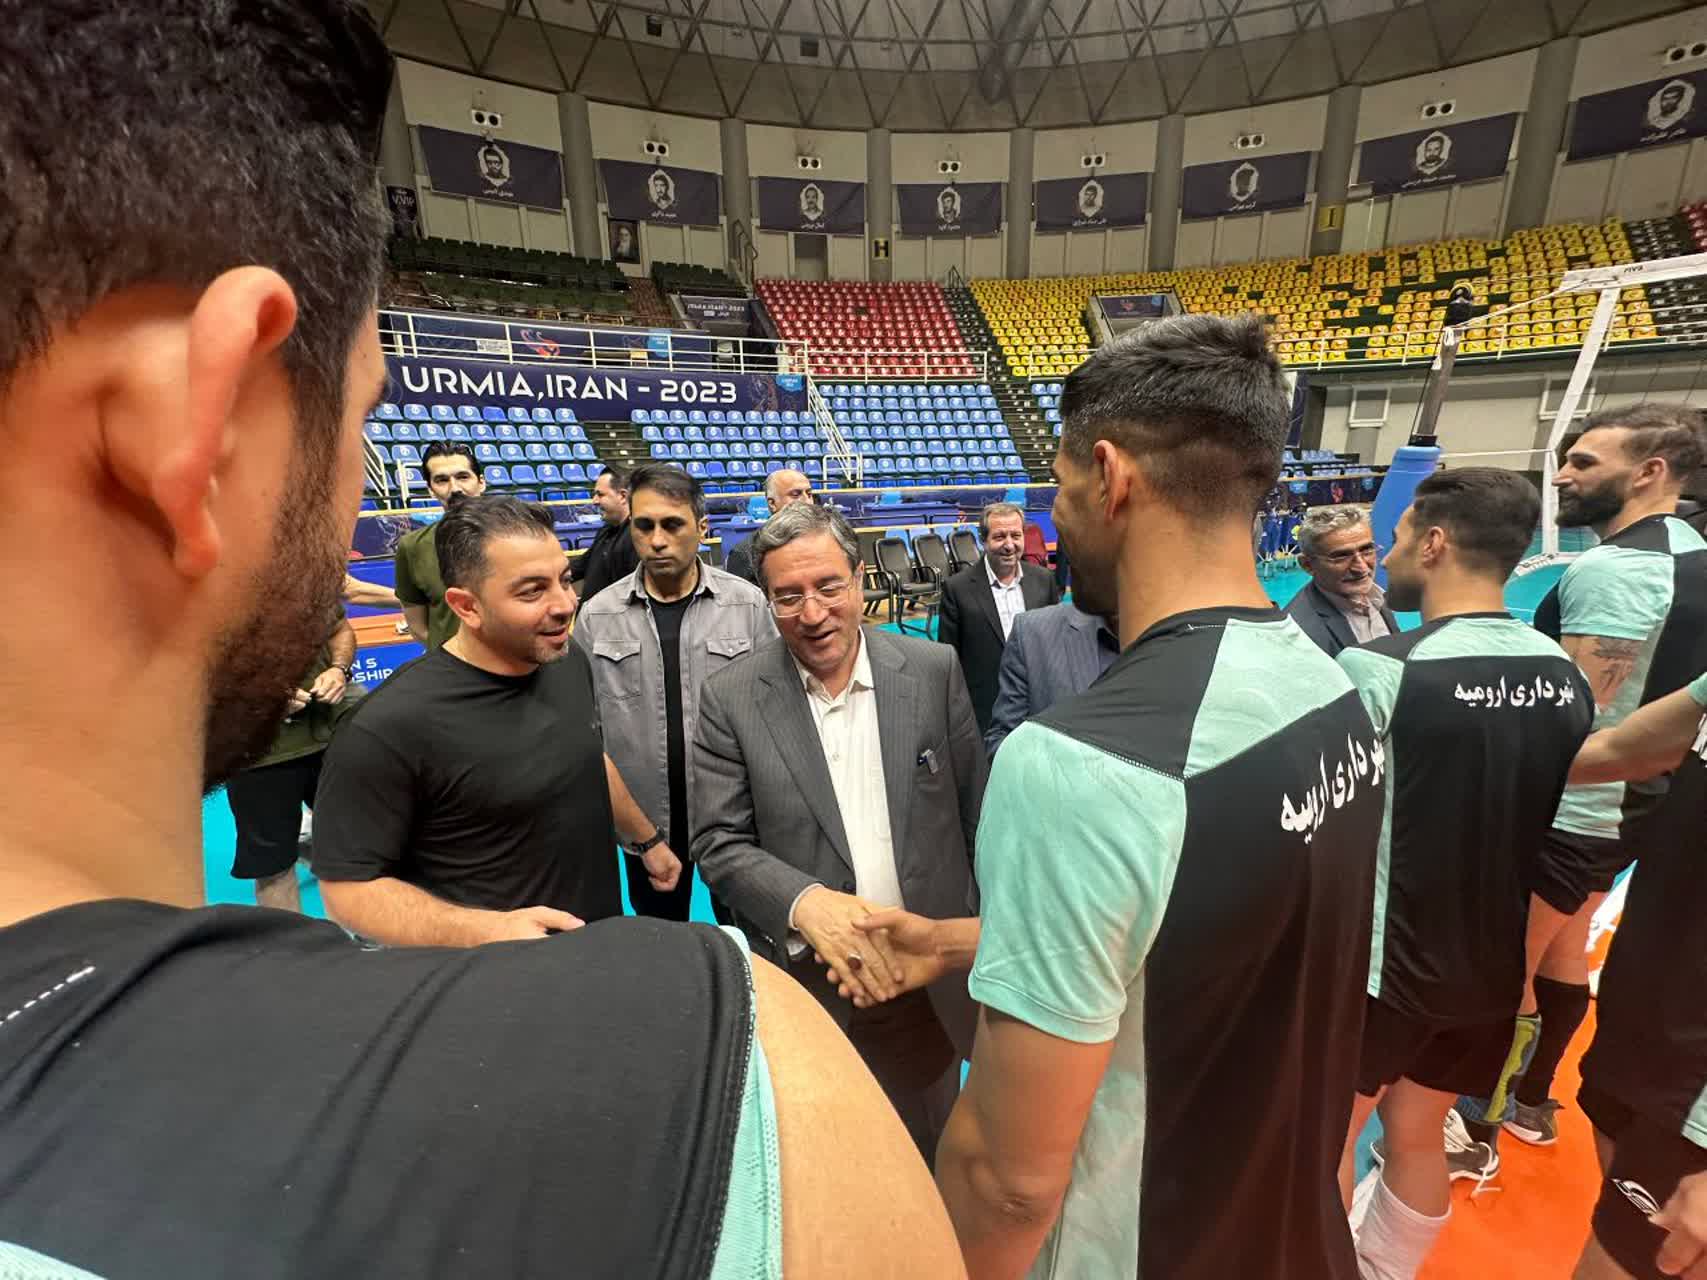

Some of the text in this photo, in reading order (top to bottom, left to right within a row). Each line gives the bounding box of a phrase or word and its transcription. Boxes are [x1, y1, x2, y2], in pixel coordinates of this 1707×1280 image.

[874, 240, 889, 257] H
[660, 379, 737, 404] 2023
[352, 668, 393, 683] SHIP
[1453, 674, 1507, 708] ارومیه
